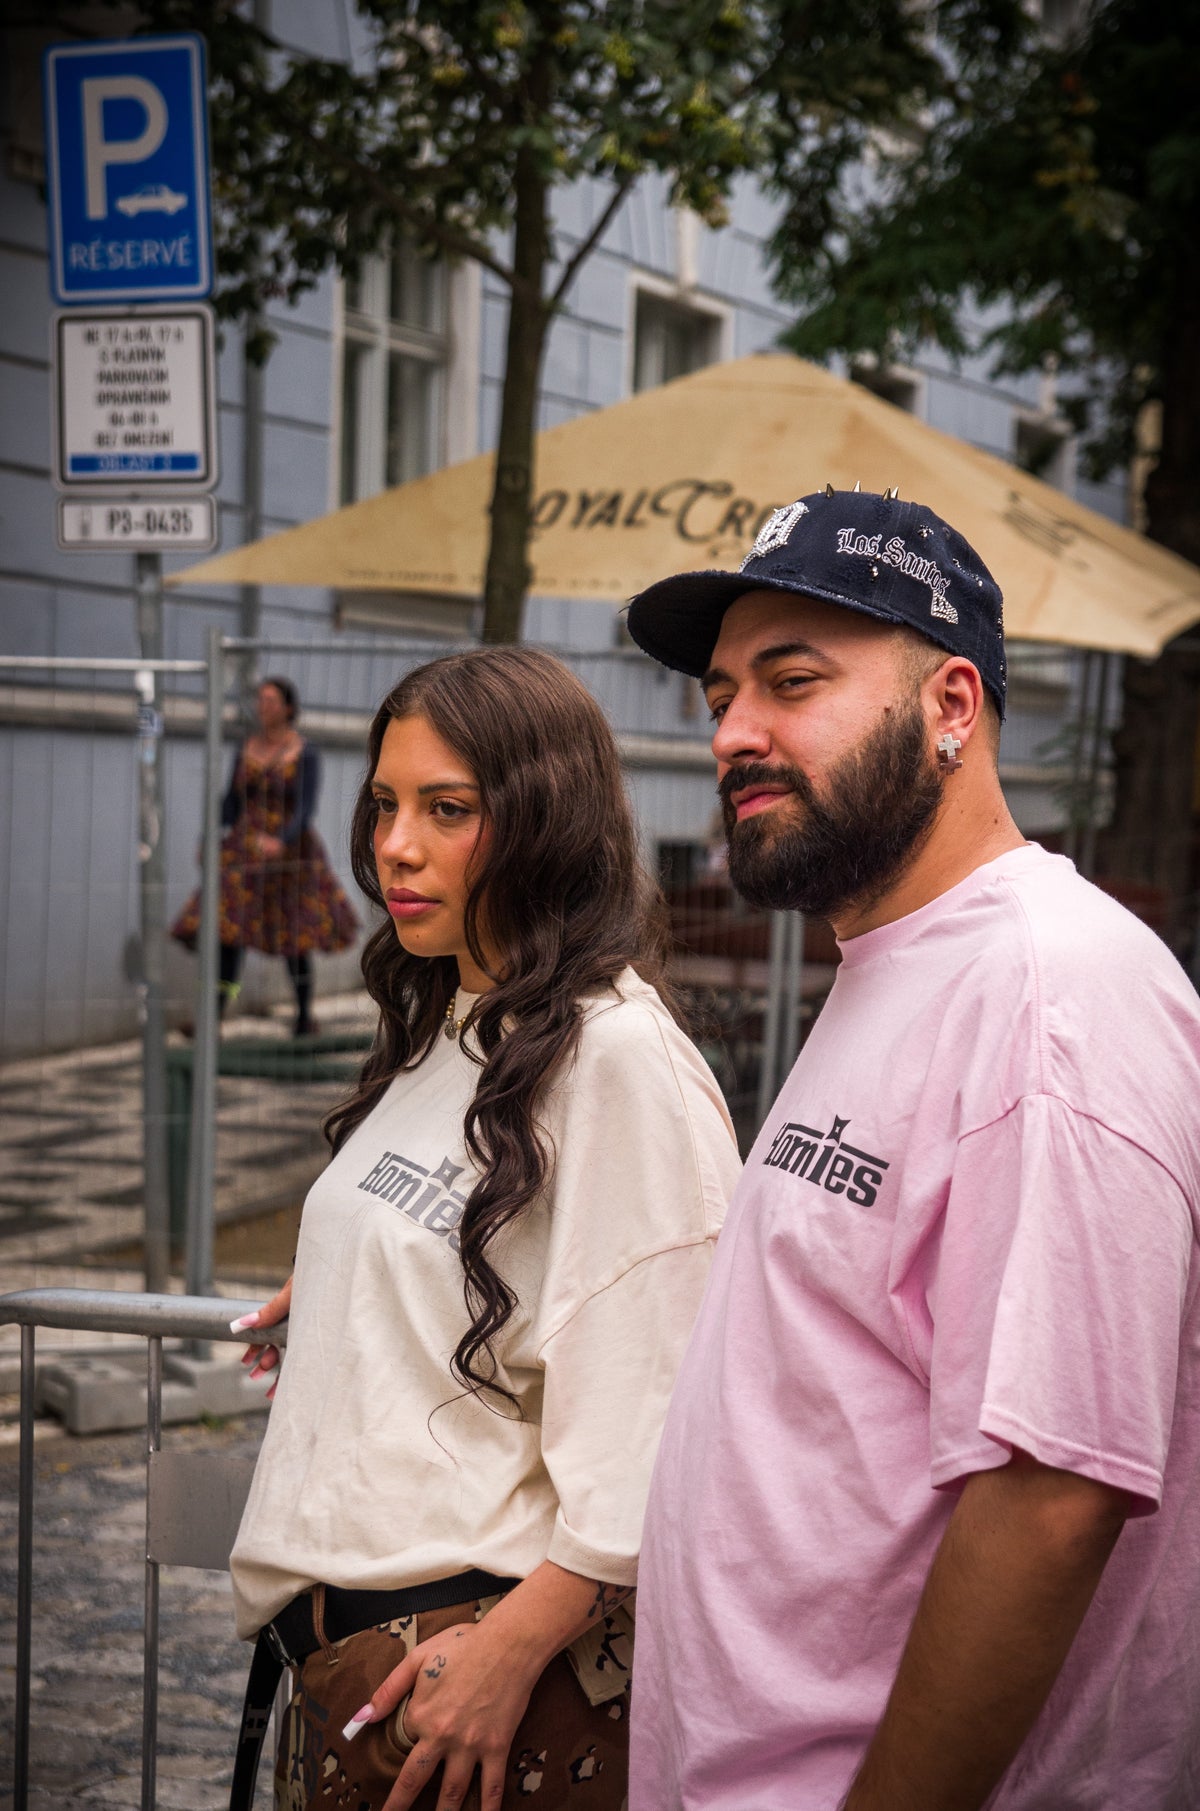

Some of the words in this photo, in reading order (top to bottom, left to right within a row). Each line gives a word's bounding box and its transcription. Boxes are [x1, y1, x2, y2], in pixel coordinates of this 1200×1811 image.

[81, 74, 169, 221] P
[69, 231, 192, 270] RÉSERVÉ
[531, 486, 654, 532] OYAL
[836, 528, 882, 556] Los
[882, 536, 951, 597] Santos
[762, 1114, 889, 1208] Homies
[357, 1151, 467, 1254] Homie
